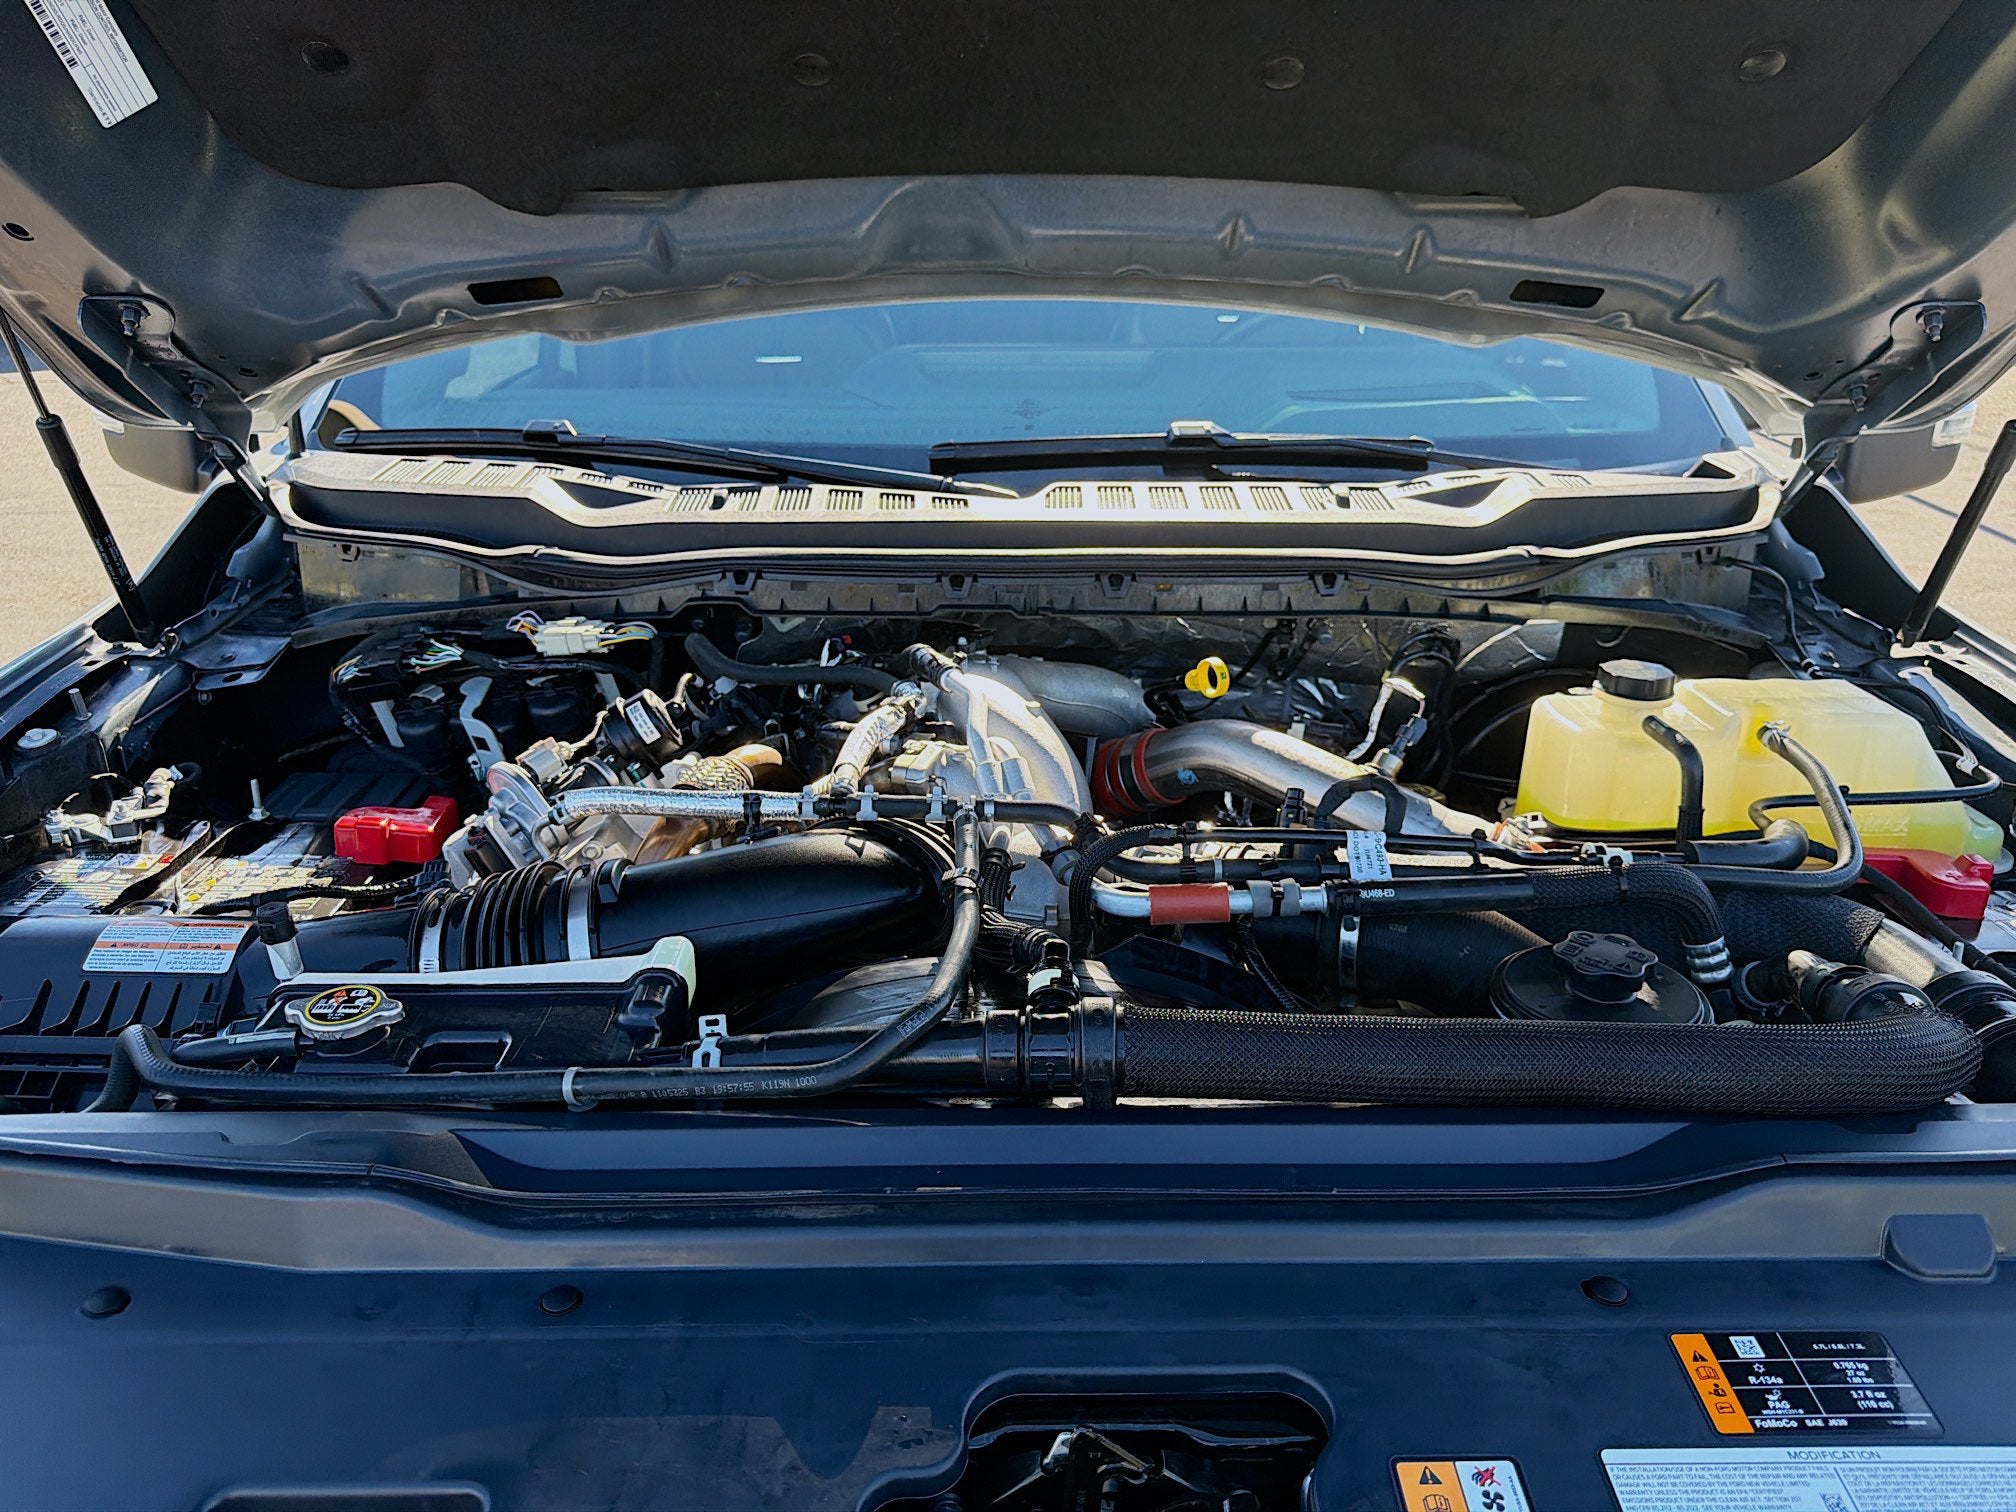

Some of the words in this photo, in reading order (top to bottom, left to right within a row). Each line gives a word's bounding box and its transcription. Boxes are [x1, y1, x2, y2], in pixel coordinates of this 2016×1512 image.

[712, 1081, 755, 1094] 19:57:55
[761, 1078, 791, 1090] K119N
[1748, 1375, 1784, 1385] R-134a
[1850, 1389, 1864, 1399] 3.7
[1874, 1390, 1887, 1399] oz
[1767, 1400, 1791, 1409] PAG
[1857, 1400, 1878, 1410] (110
[1878, 1400, 1895, 1410] cc)
[1754, 1418, 1798, 1428] FoMoCo
[1804, 1418, 1825, 1427] SAE
[1786, 1450, 1882, 1461] MODIFICATION
